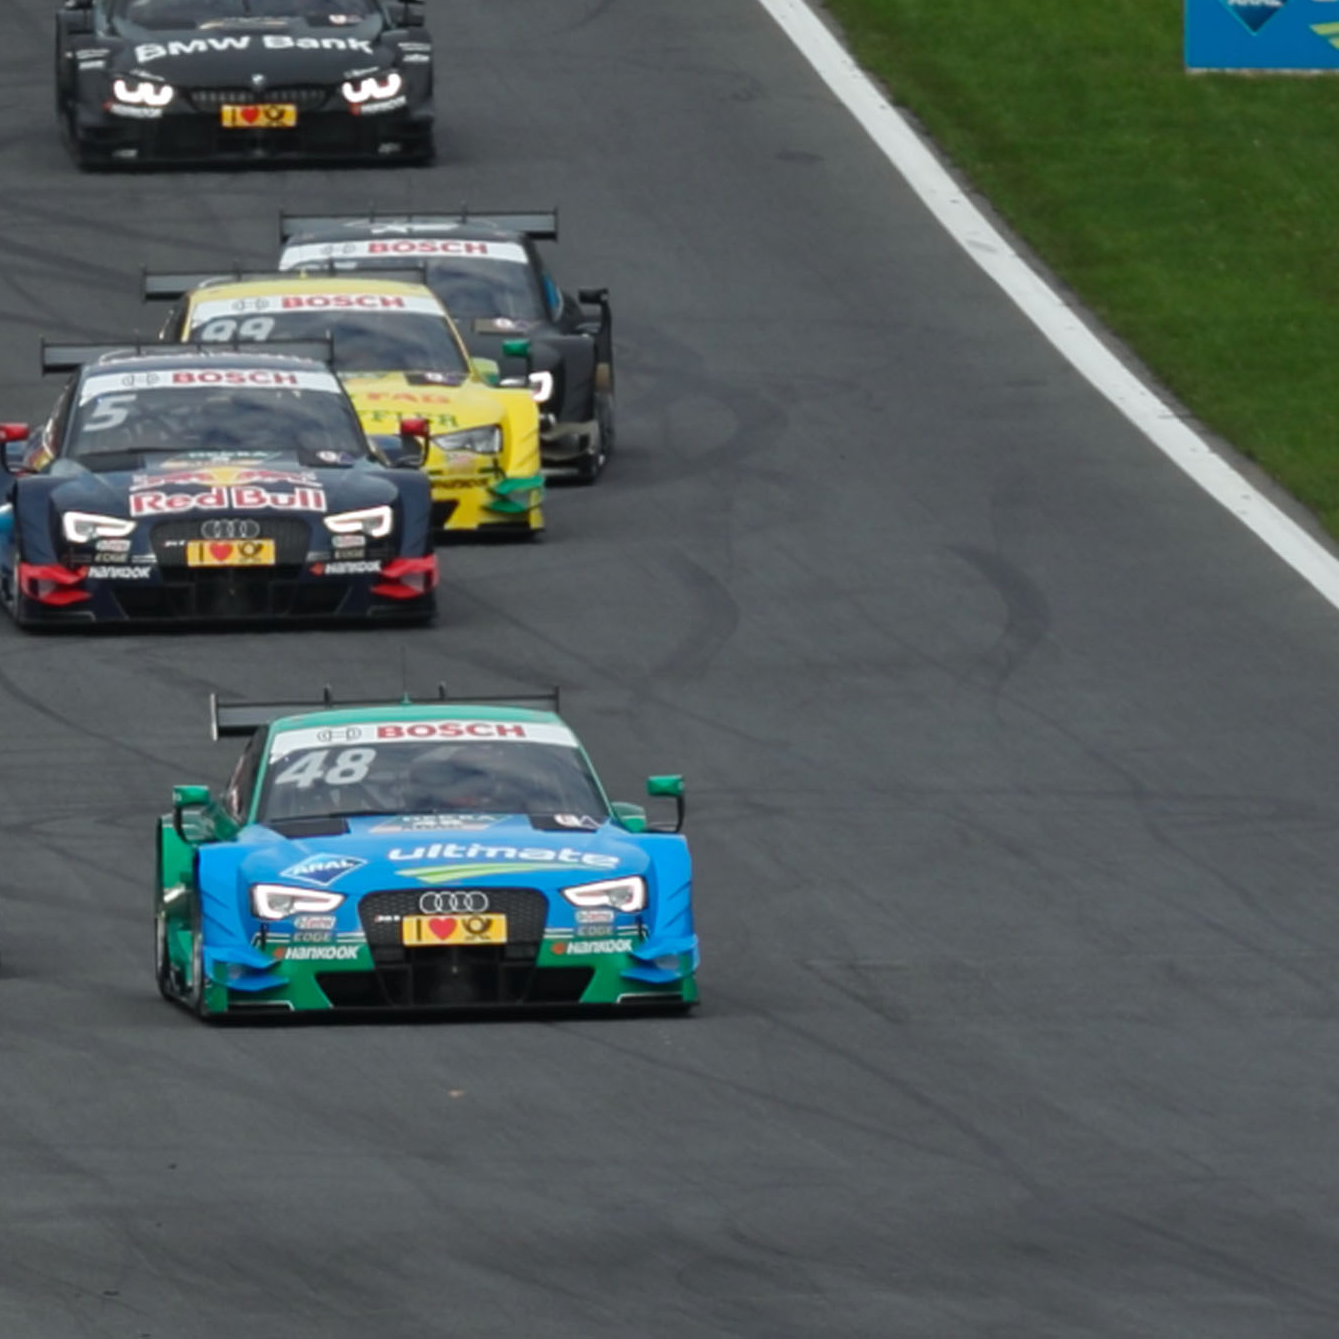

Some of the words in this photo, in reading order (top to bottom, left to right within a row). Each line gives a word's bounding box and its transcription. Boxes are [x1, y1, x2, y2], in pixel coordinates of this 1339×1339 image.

[134, 36, 251, 63] BMW
[262, 35, 374, 54] Bank
[367, 241, 488, 255] BOSCH
[281, 296, 405, 310] BOSCH
[201, 316, 275, 341] 99
[171, 371, 298, 385] BOSCH
[81, 394, 136, 432] 5
[130, 487, 227, 517] Red
[232, 486, 326, 512] Bull
[376, 721, 527, 739] BOSCH
[274, 747, 377, 789] 48
[293, 859, 355, 876] ARAL
[387, 843, 621, 869] ultimate
